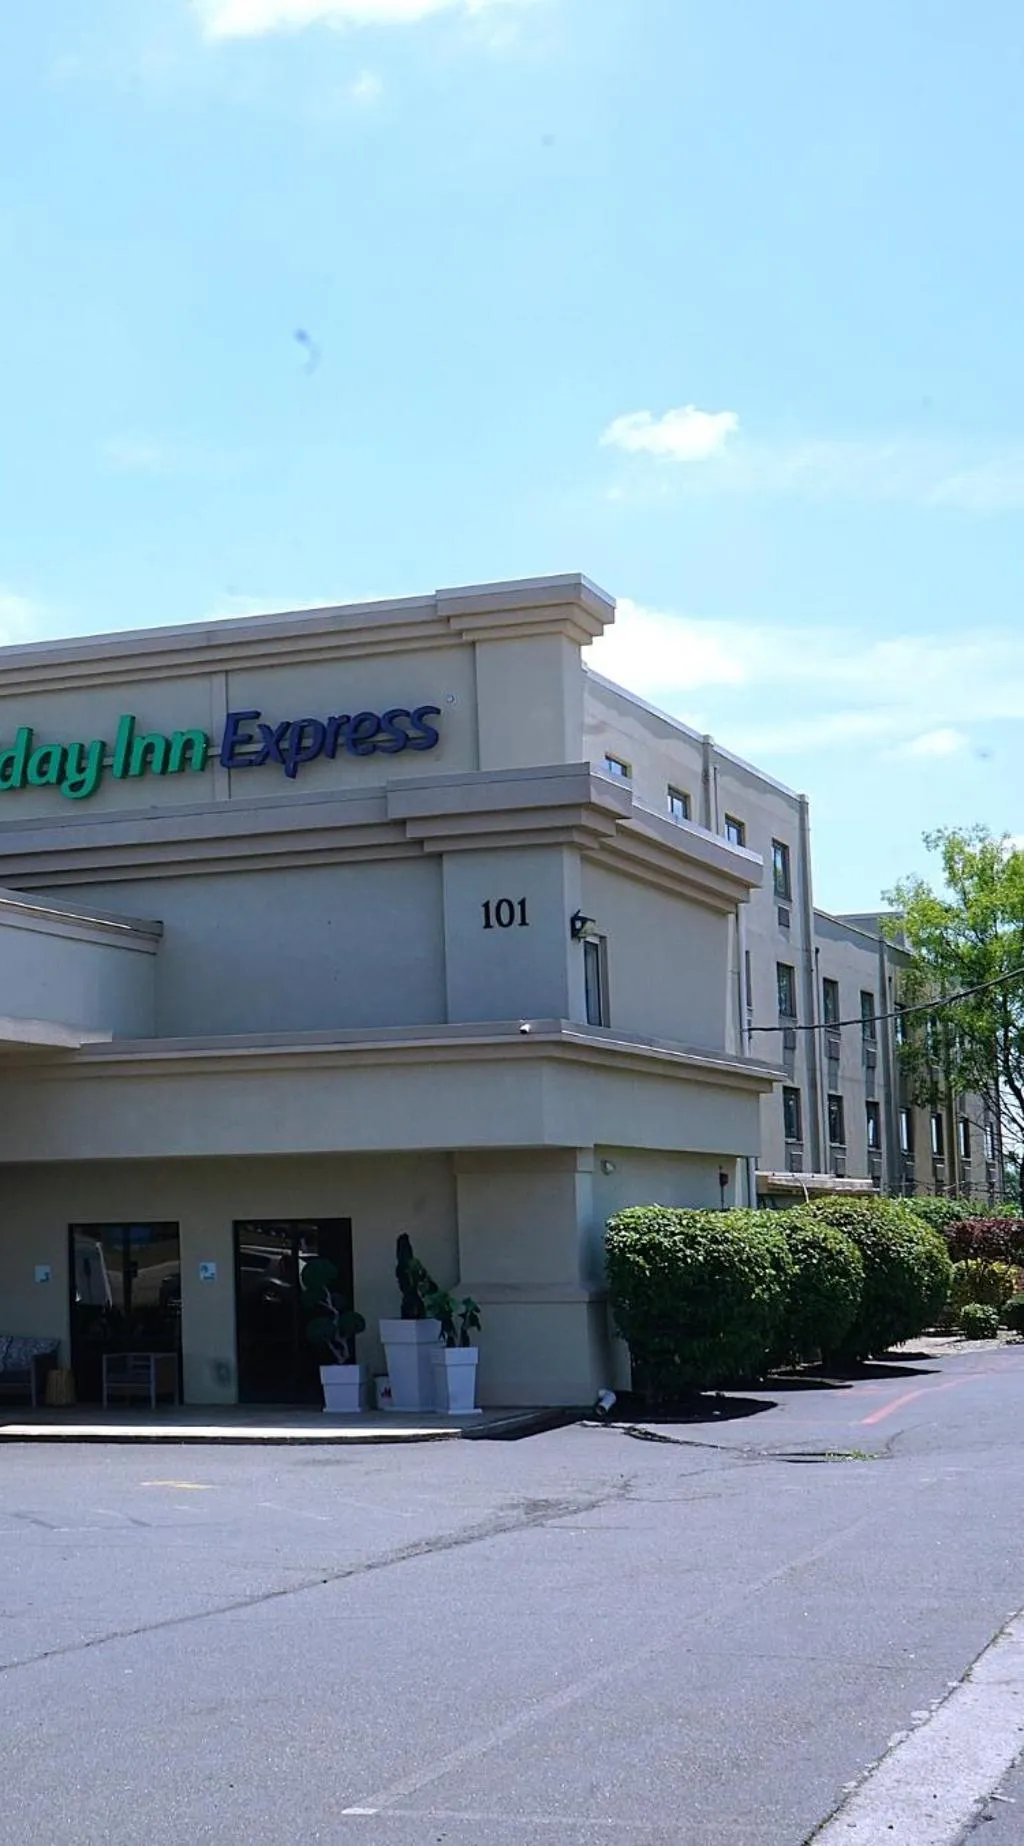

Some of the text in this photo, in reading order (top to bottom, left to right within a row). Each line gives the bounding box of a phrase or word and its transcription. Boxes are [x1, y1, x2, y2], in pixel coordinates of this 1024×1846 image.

[112, 714, 209, 780] Inn
[220, 705, 441, 779] Express
[481, 897, 529, 929] 101
